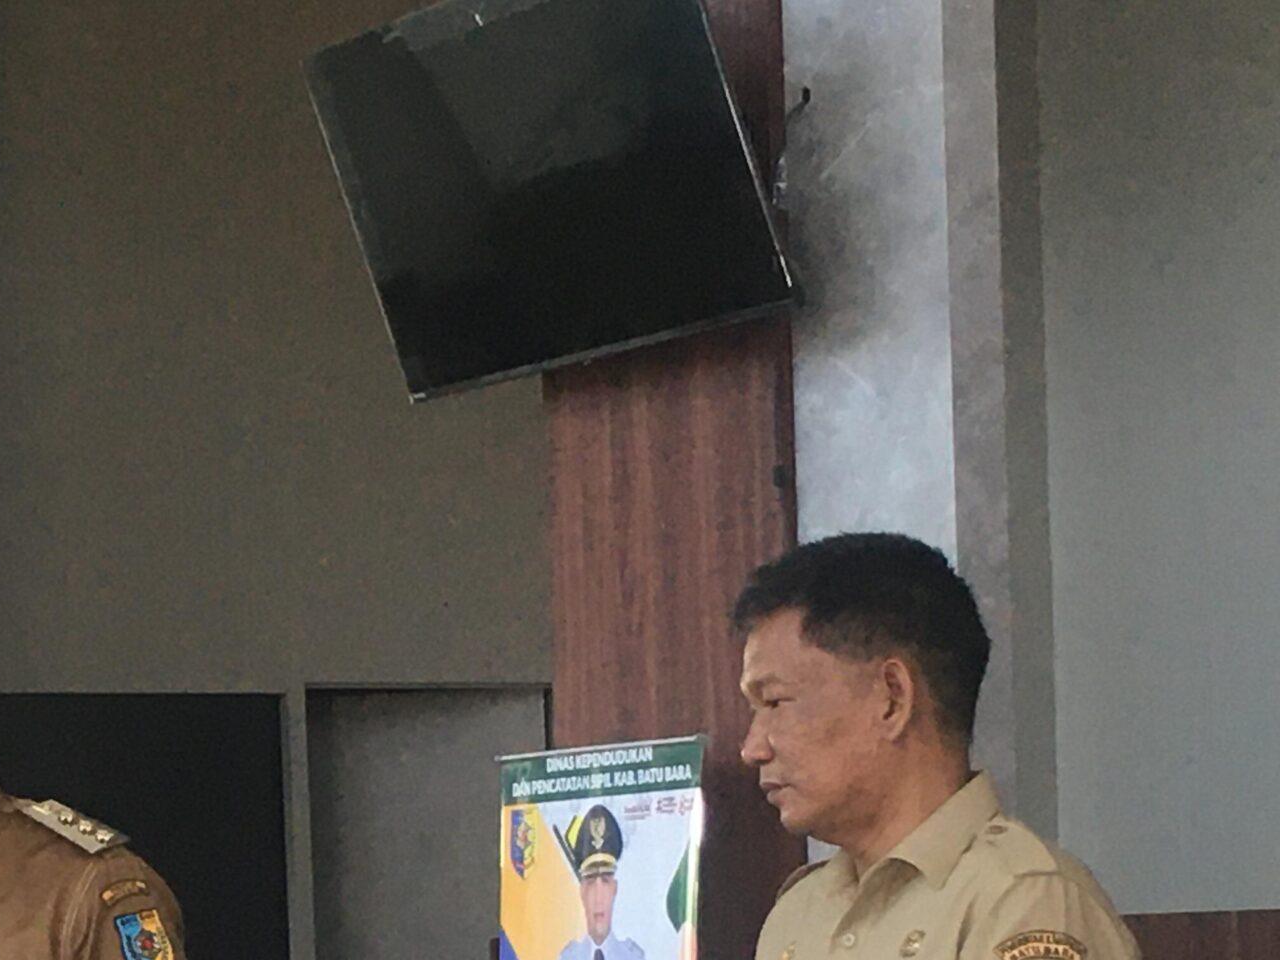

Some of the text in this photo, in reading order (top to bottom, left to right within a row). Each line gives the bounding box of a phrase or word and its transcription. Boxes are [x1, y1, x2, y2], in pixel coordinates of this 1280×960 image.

[546, 746, 653, 773] DINAS KEPENDUDUKAN
[512, 779, 531, 797] DAN
[532, 774, 590, 795] PENCATATAN
[638, 766, 663, 784] BATU
[664, 764, 692, 782] BARA
